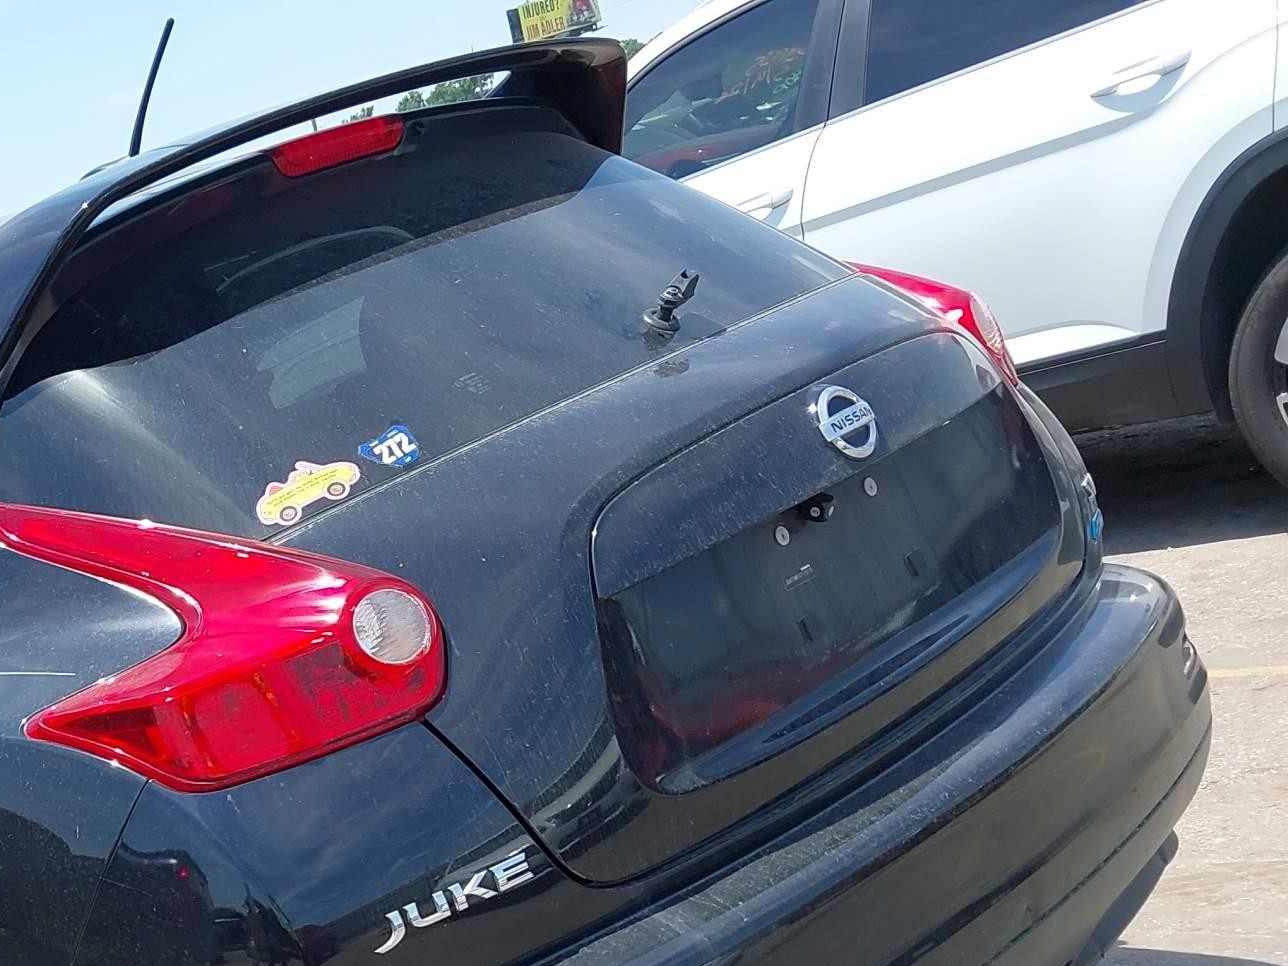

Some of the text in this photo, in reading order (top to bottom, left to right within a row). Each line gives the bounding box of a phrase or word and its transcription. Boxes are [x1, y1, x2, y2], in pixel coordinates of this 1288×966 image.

[522, 0, 560, 19] INJURED?
[526, 16, 566, 40] JIM ADLER
[830, 406, 872, 433] NISSAN
[372, 432, 417, 465] 272
[373, 851, 536, 955] JUKE
